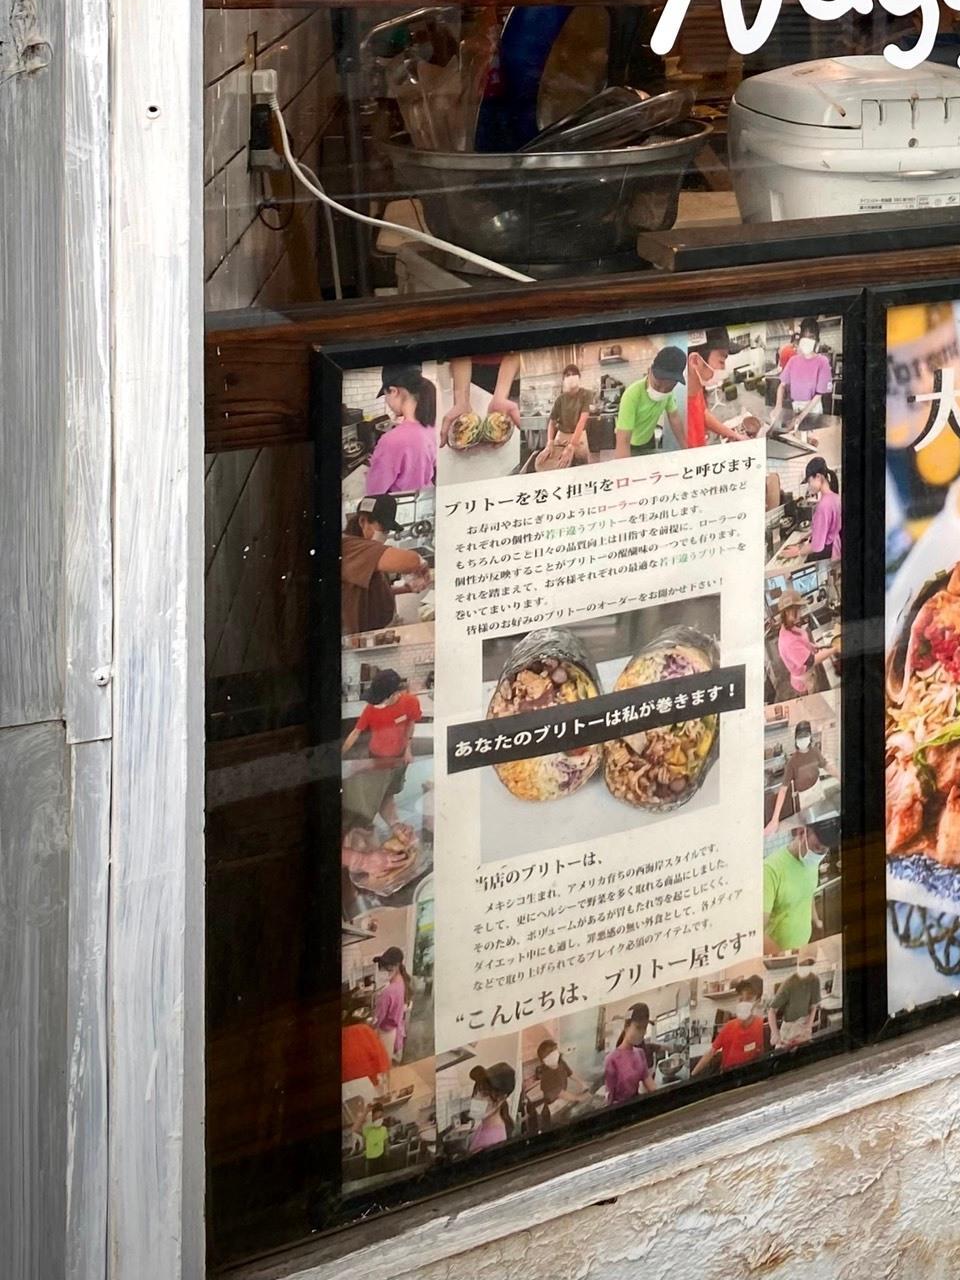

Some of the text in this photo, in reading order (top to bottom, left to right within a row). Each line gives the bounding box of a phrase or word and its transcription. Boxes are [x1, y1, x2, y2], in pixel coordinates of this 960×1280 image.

[454, 682, 736, 759] あなたのブリトーは私が巻きます！
